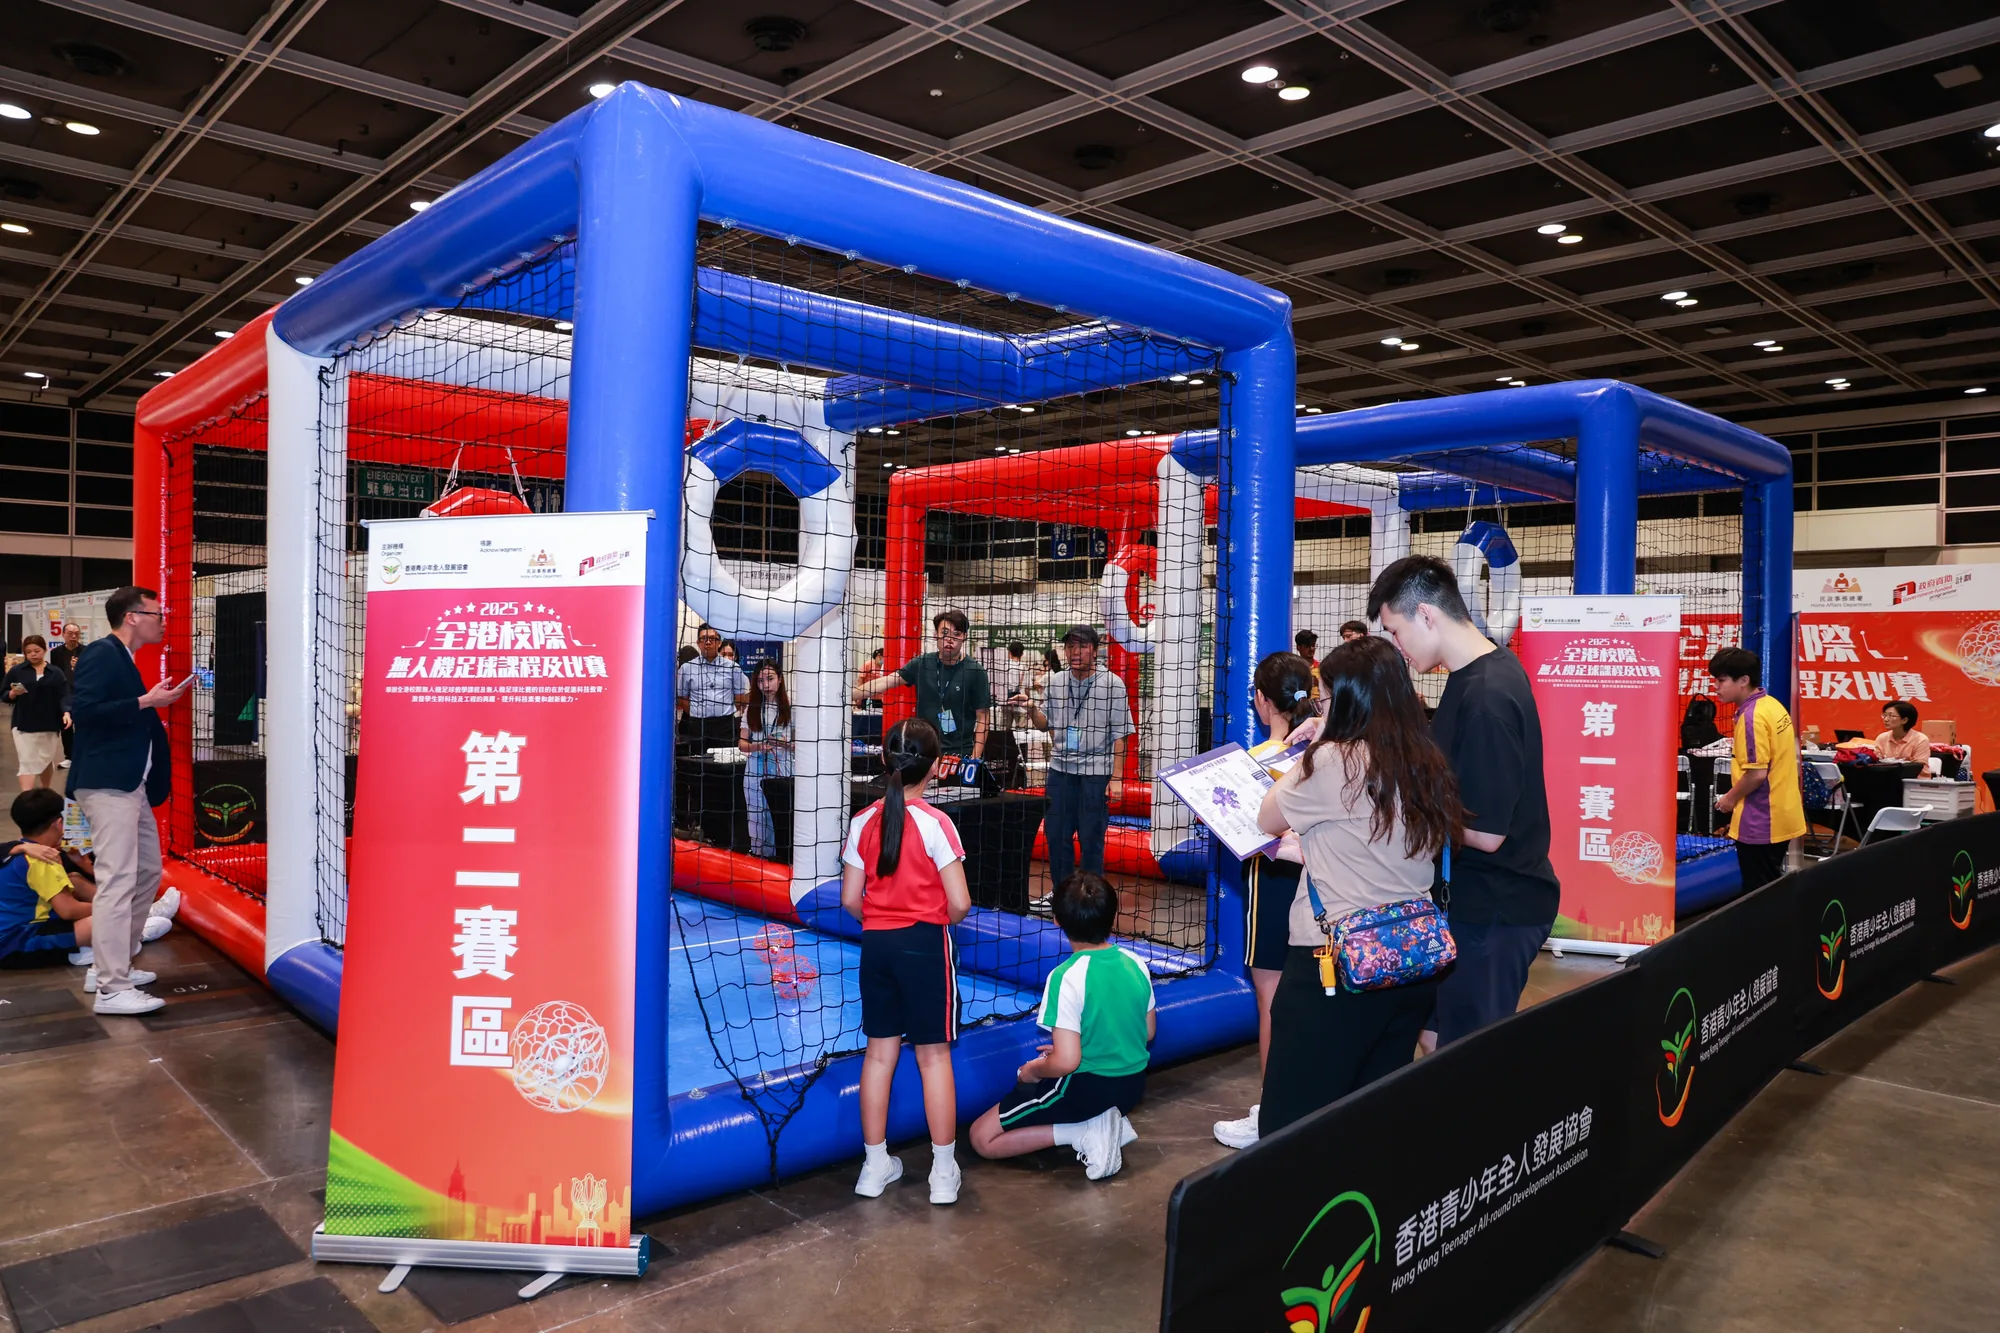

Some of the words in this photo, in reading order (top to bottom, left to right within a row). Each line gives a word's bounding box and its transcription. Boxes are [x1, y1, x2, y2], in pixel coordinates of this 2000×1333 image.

[411, 474, 425, 484] EXIT
[1918, 574, 1953, 591] 政府資助
[1955, 573, 1972, 585] 計劃
[1903, 584, 1953, 602] Government-funded
[1929, 589, 1957, 601] programme
[480, 602, 519, 616] 2025
[50, 621, 62, 636] 5
[429, 620, 569, 651] 全港校際
[1561, 647, 1638, 663] 全港校際
[385, 655, 609, 679] 無人機足球課程及比賽
[1537, 664, 1663, 677] 無人機足球課程及比賽
[964, 763, 976, 783] 0
[1579, 701, 1618, 863] 第一賽區
[449, 730, 527, 1067] 第二賽區
[1850, 897, 1916, 947] 香港青少年全人發展協會
[1700, 965, 1779, 1045] 香港青少年全人發展協會
[1395, 1105, 1593, 1266] 香港青少年全人發展協會
[1391, 1266, 1415, 1293] Hong
[1417, 1251, 1439, 1275] Kong
[1440, 1225, 1477, 1258] Teenager
[1477, 1200, 1511, 1233] All-round
[1512, 1170, 1555, 1207] Development
[1555, 1148, 1588, 1177] Association
